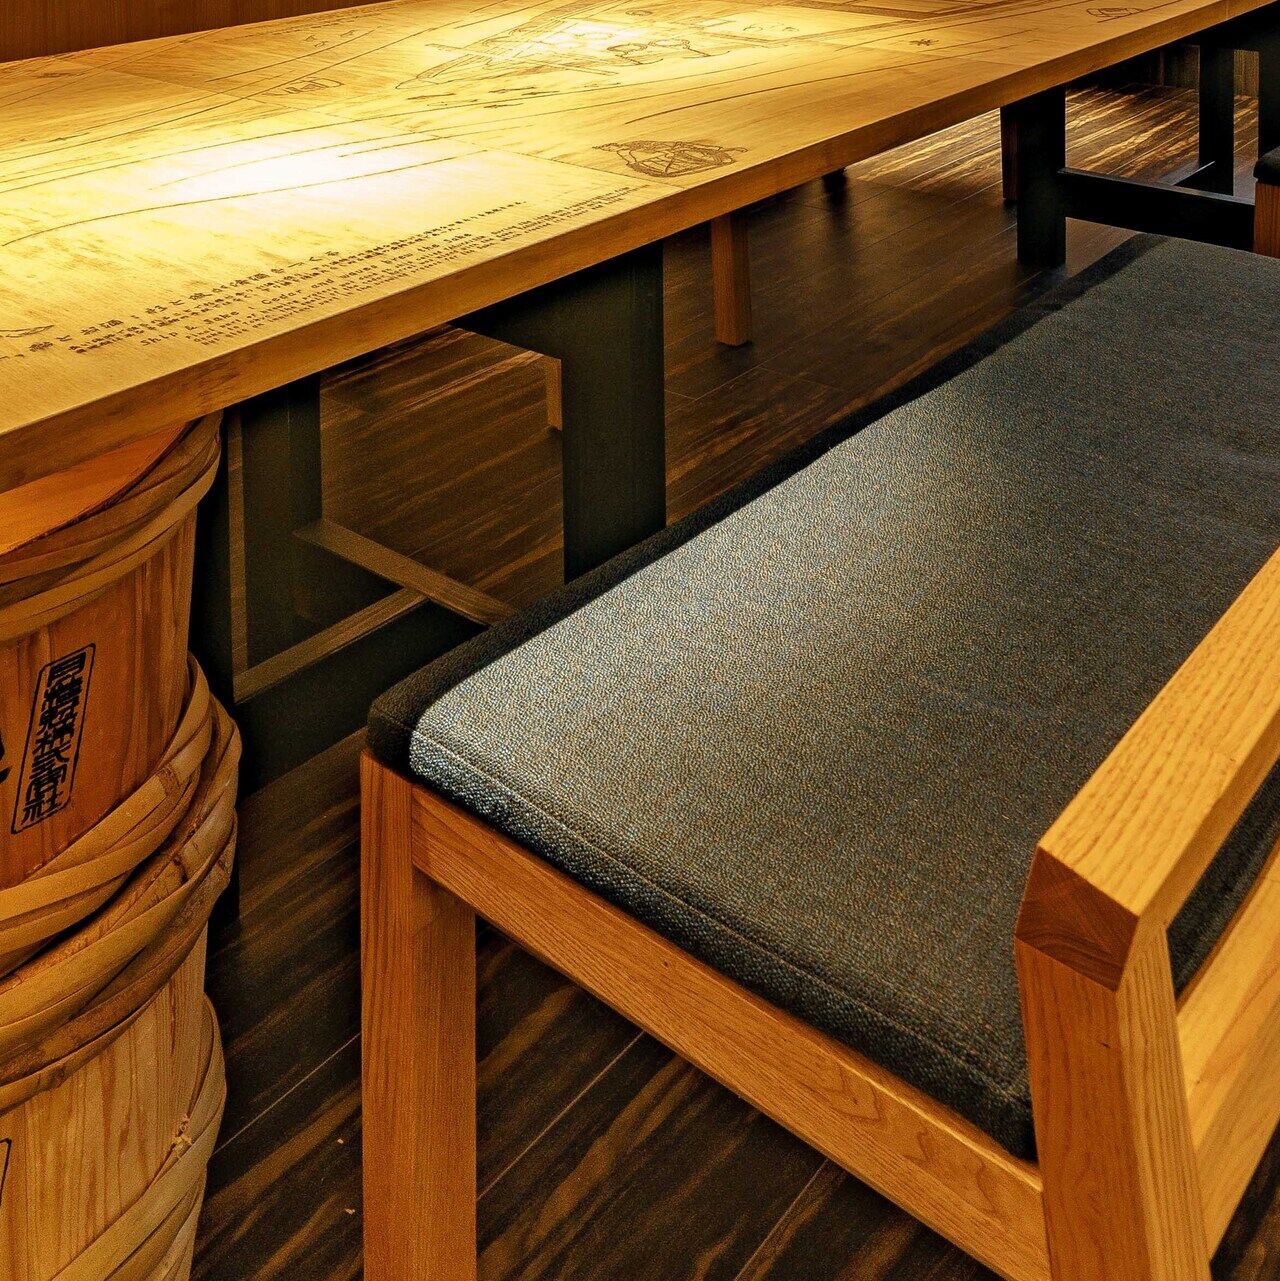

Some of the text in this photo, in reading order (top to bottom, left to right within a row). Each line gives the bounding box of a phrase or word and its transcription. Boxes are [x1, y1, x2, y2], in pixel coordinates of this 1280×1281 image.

[140, 331, 178, 346] Ship
[204, 311, 239, 324] Sake
[261, 289, 302, 305] Cedar
[311, 278, 334, 289] and
[417, 243, 439, 252] the
[443, 232, 472, 244] Sake
